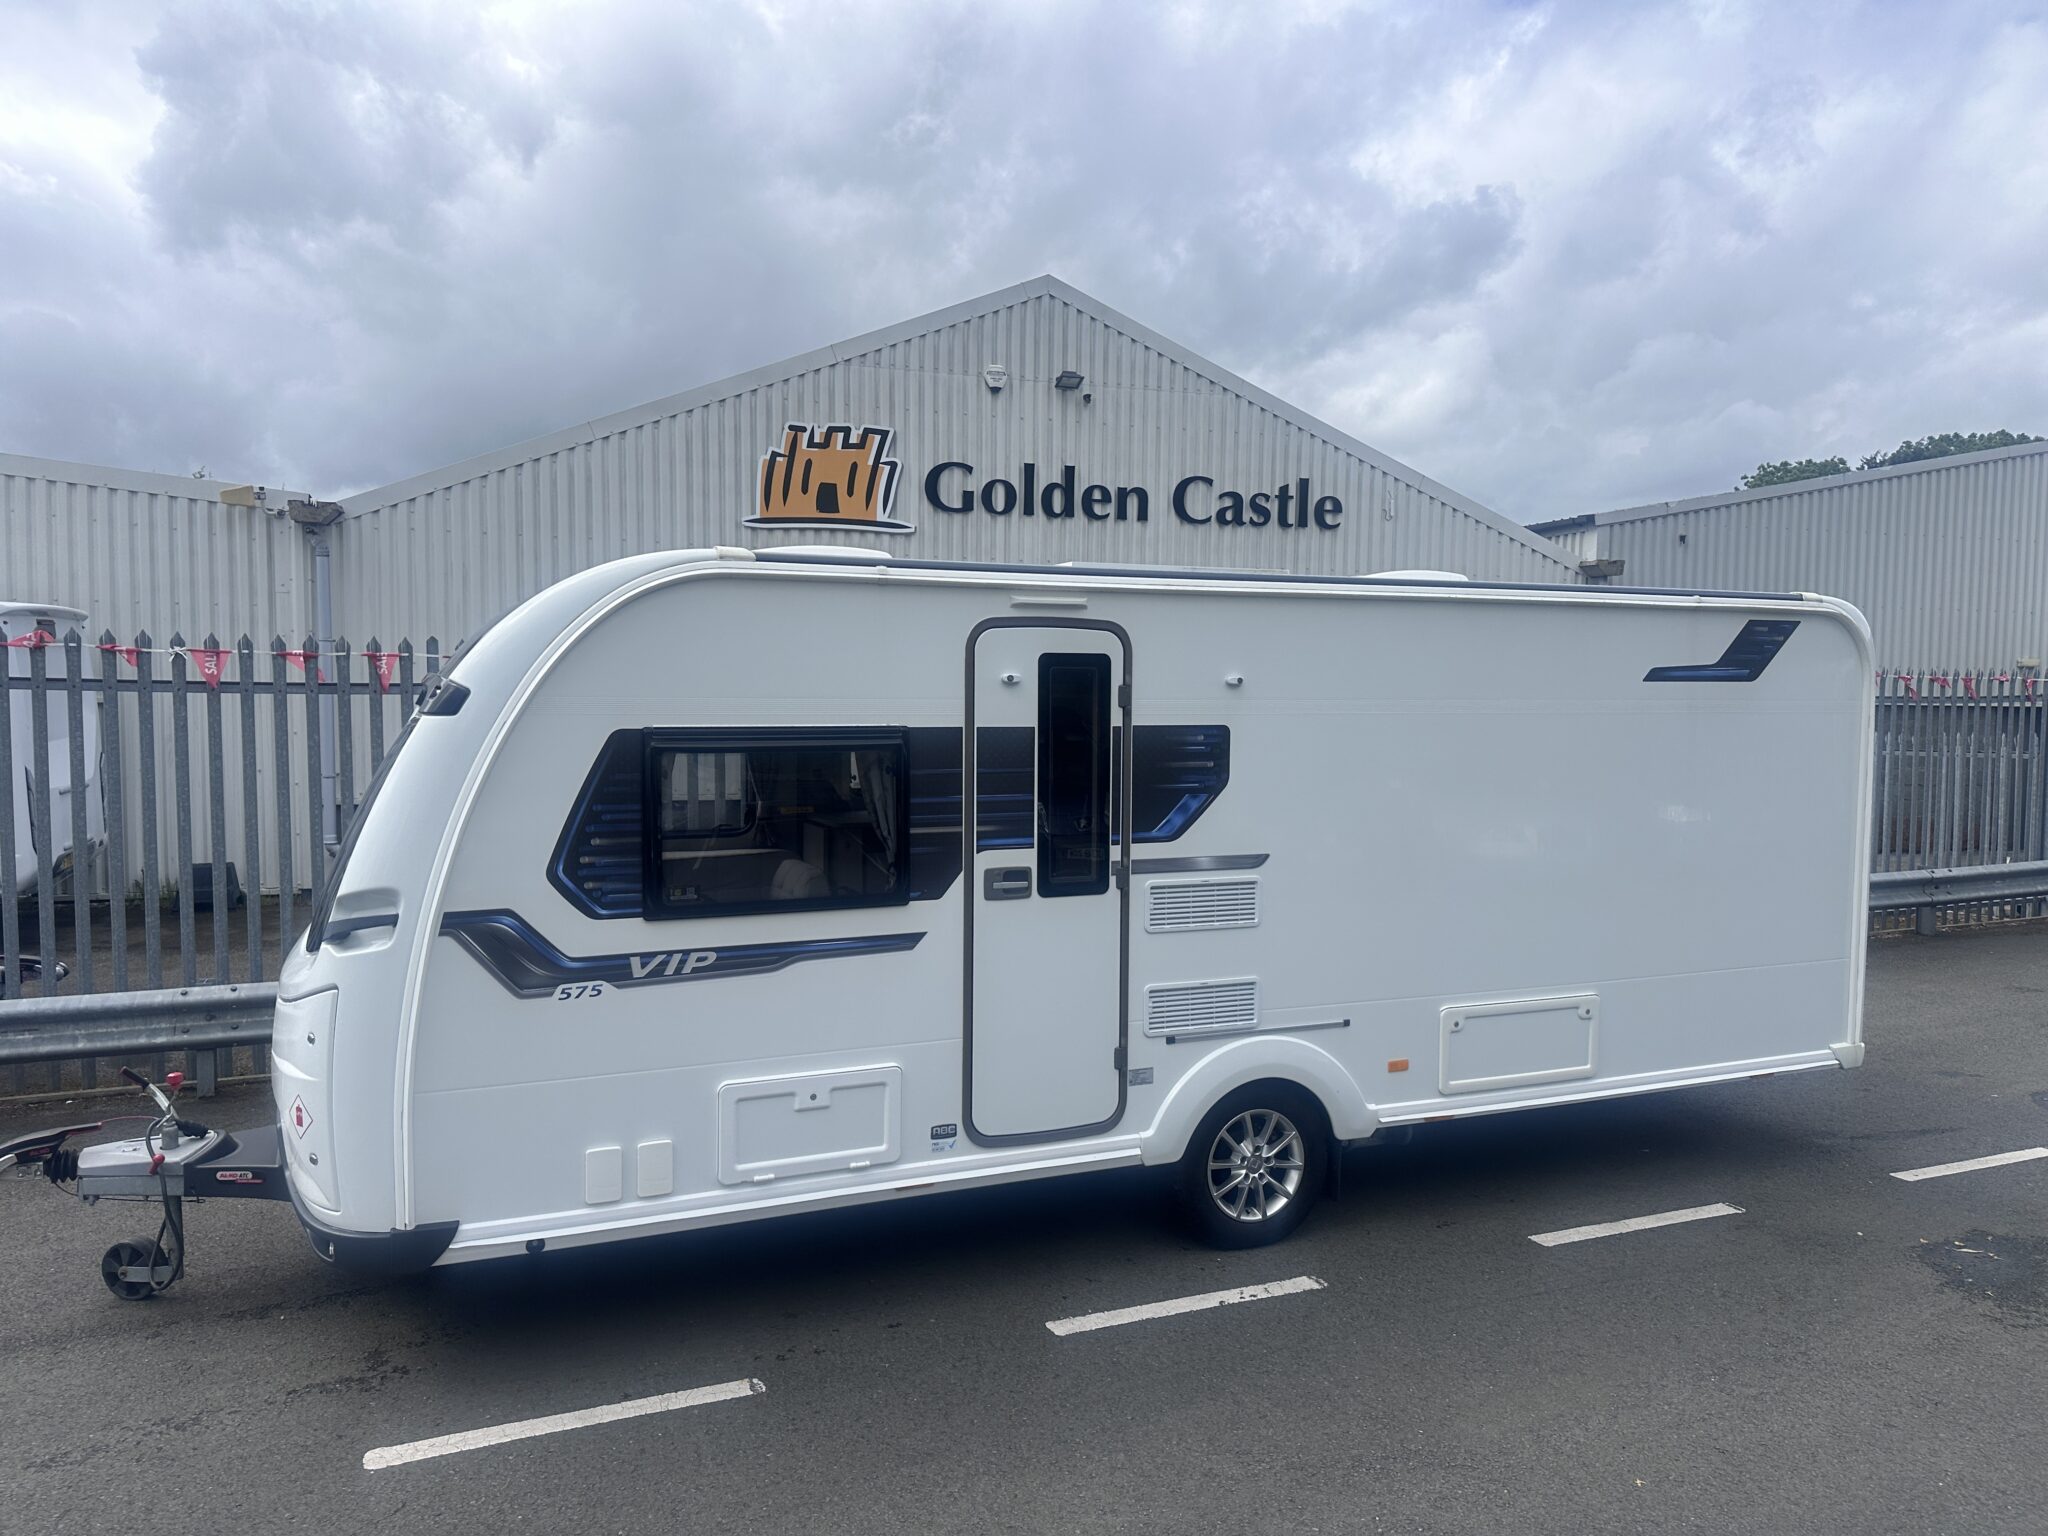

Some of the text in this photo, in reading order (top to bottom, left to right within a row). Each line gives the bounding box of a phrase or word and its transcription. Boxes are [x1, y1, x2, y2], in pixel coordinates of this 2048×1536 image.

[924, 461, 1344, 530] Golden Castle
[629, 951, 718, 978] VIP
[557, 984, 604, 1001] 575
